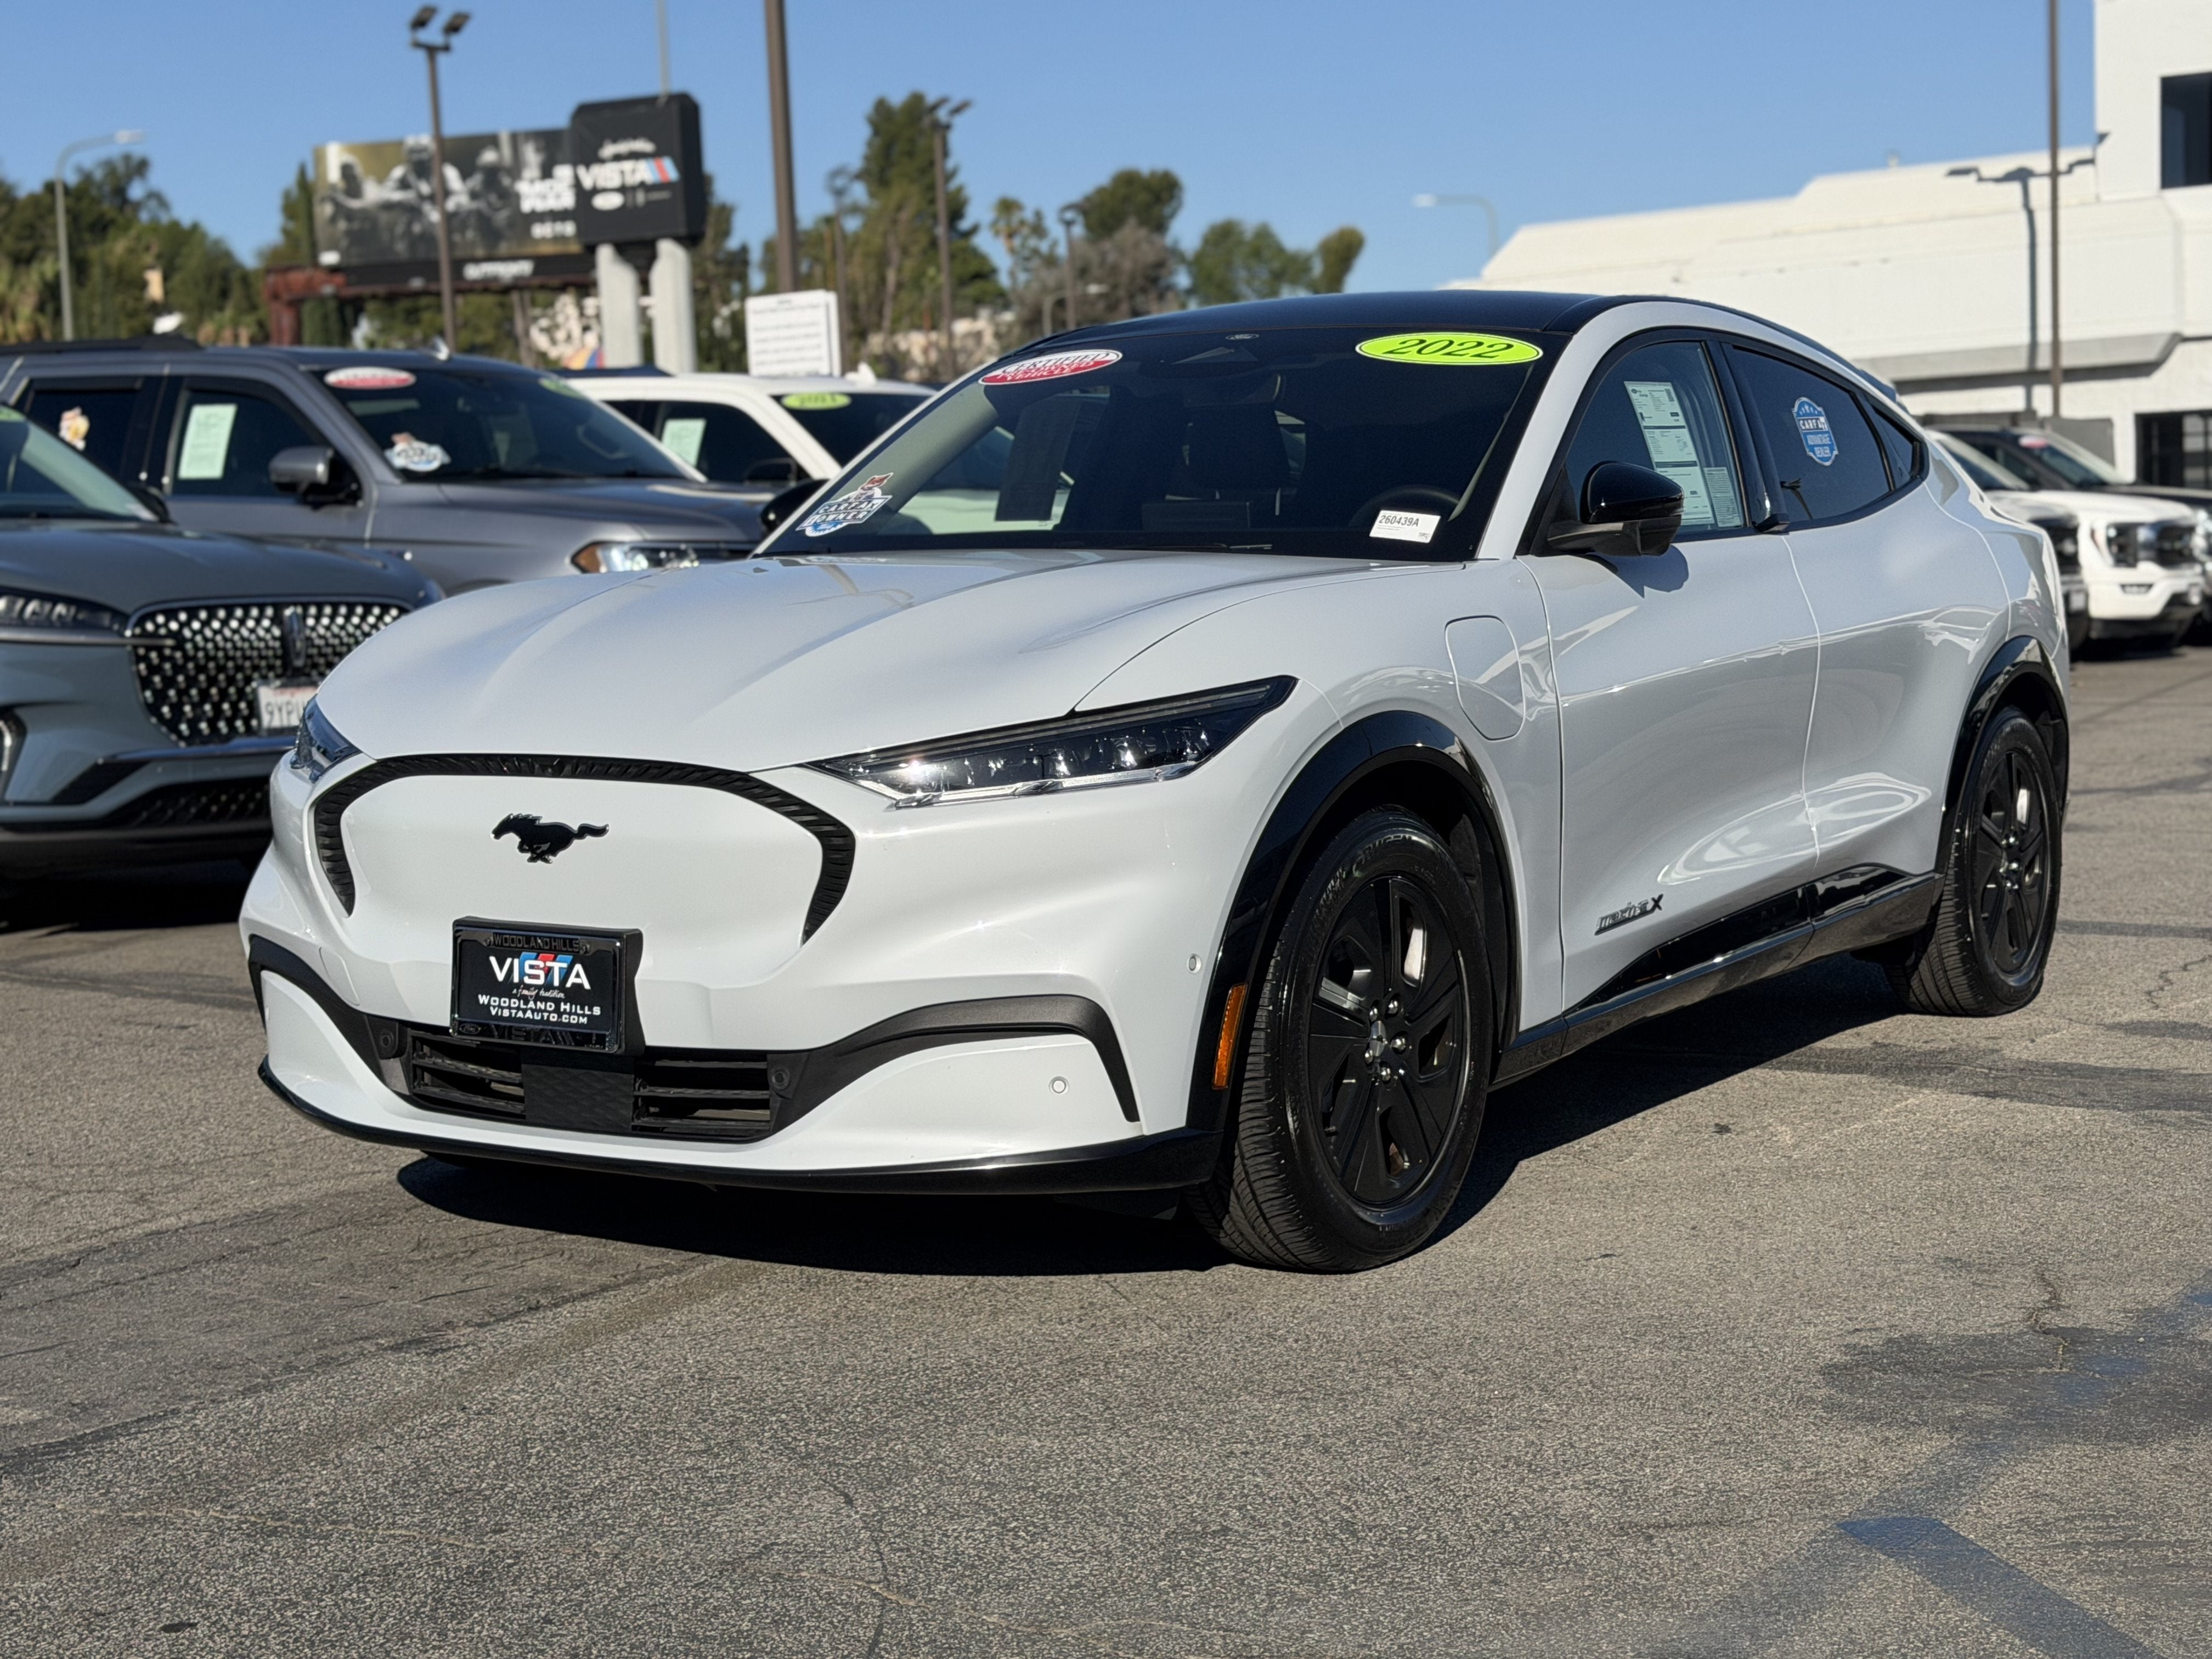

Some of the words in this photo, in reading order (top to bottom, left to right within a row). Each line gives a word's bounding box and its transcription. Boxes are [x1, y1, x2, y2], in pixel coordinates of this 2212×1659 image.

[1383, 338, 1514, 359] 2022
[1002, 353, 1110, 373] CERTIFIED
[1007, 368, 1075, 381] VEHICLE
[819, 500, 878, 514] CARFAX
[1378, 515, 1420, 527] 260439A
[489, 956, 591, 990] VISTA
